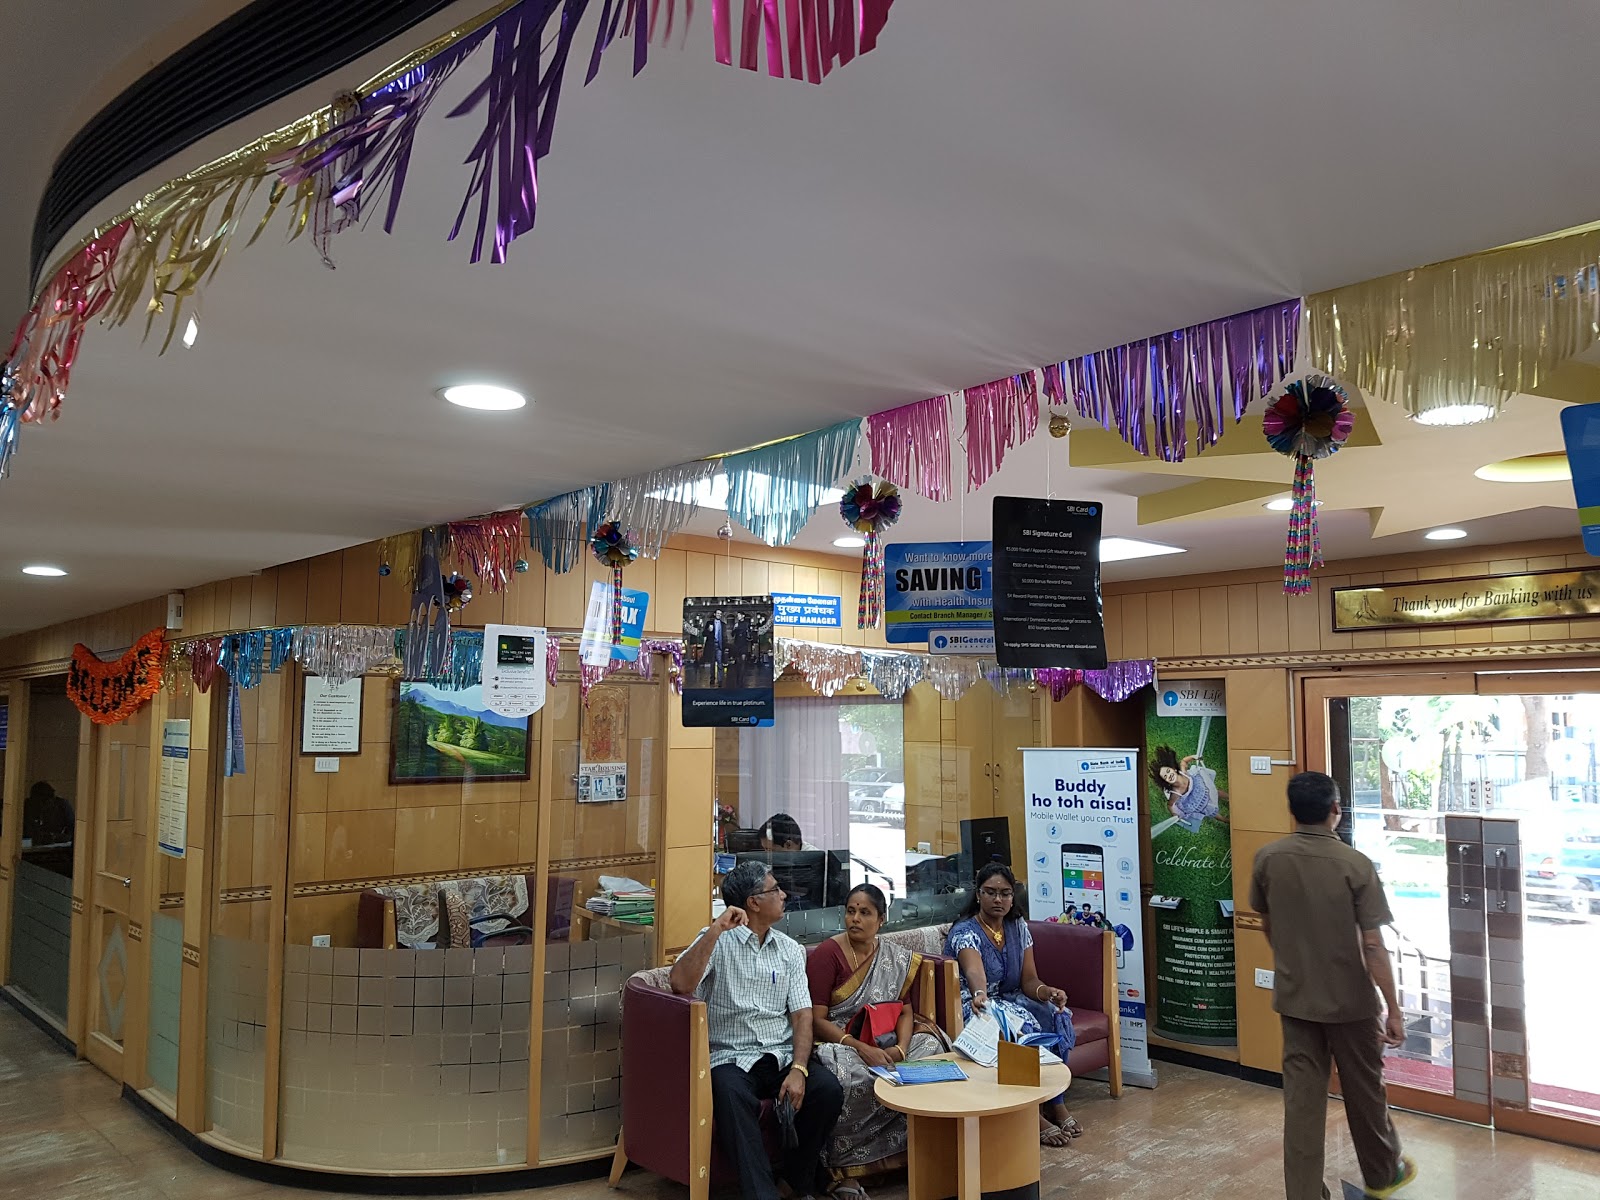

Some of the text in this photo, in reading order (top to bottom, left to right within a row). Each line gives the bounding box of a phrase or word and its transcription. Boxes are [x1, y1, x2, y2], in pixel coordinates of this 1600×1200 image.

[1032, 530, 1058, 538] Signature
[905, 552, 992, 562] Want to know more
[896, 566, 982, 592] SAVING
[912, 596, 932, 606] with
[934, 596, 965, 607] Health
[1392, 585, 1593, 613] Thank you for Banking with us
[800, 616, 837, 625] MANAGER
[934, 611, 954, 619] Branch
[956, 611, 982, 620] Manager
[1180, 690, 1222, 702] SBI Life
[594, 780, 602, 790] 17
[1055, 778, 1106, 796] Buddy
[1032, 793, 1131, 810] ho toh aisa!
[1030, 812, 1054, 820] Mobile
[1055, 812, 1078, 821] Wallet
[1156, 846, 1216, 868] Celebrate
